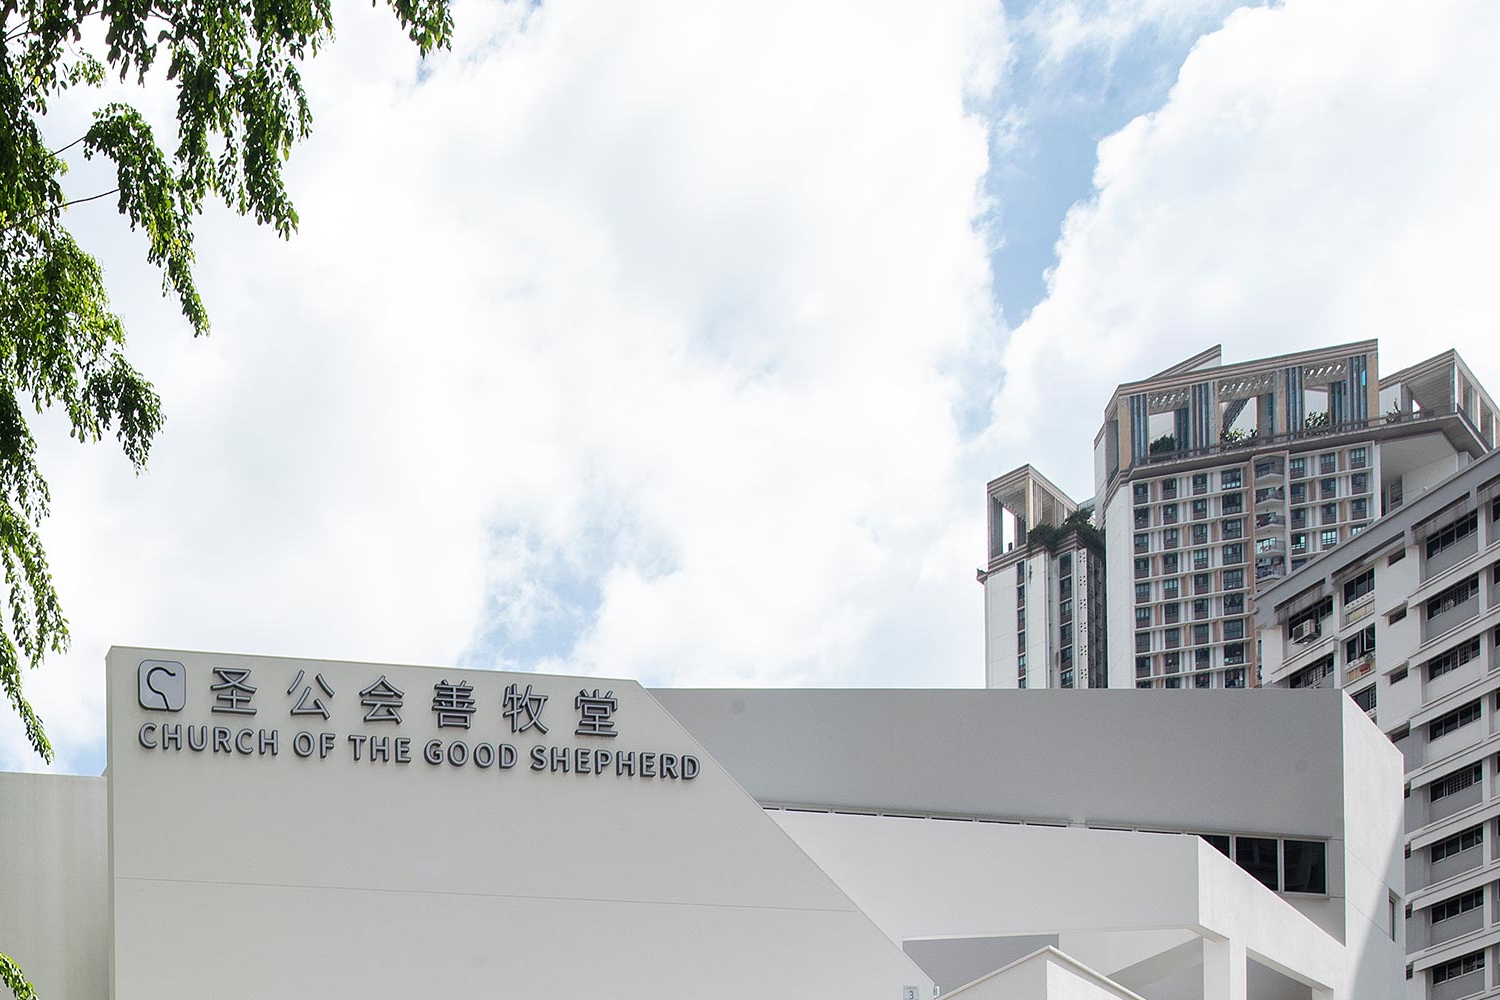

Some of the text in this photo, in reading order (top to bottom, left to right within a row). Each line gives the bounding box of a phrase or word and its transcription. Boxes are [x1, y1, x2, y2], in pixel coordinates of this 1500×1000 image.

[210, 666, 619, 738] 圣公会善牧堂
[138, 722, 700, 780] CHURCH OF THE GOOD SHEPHERD
